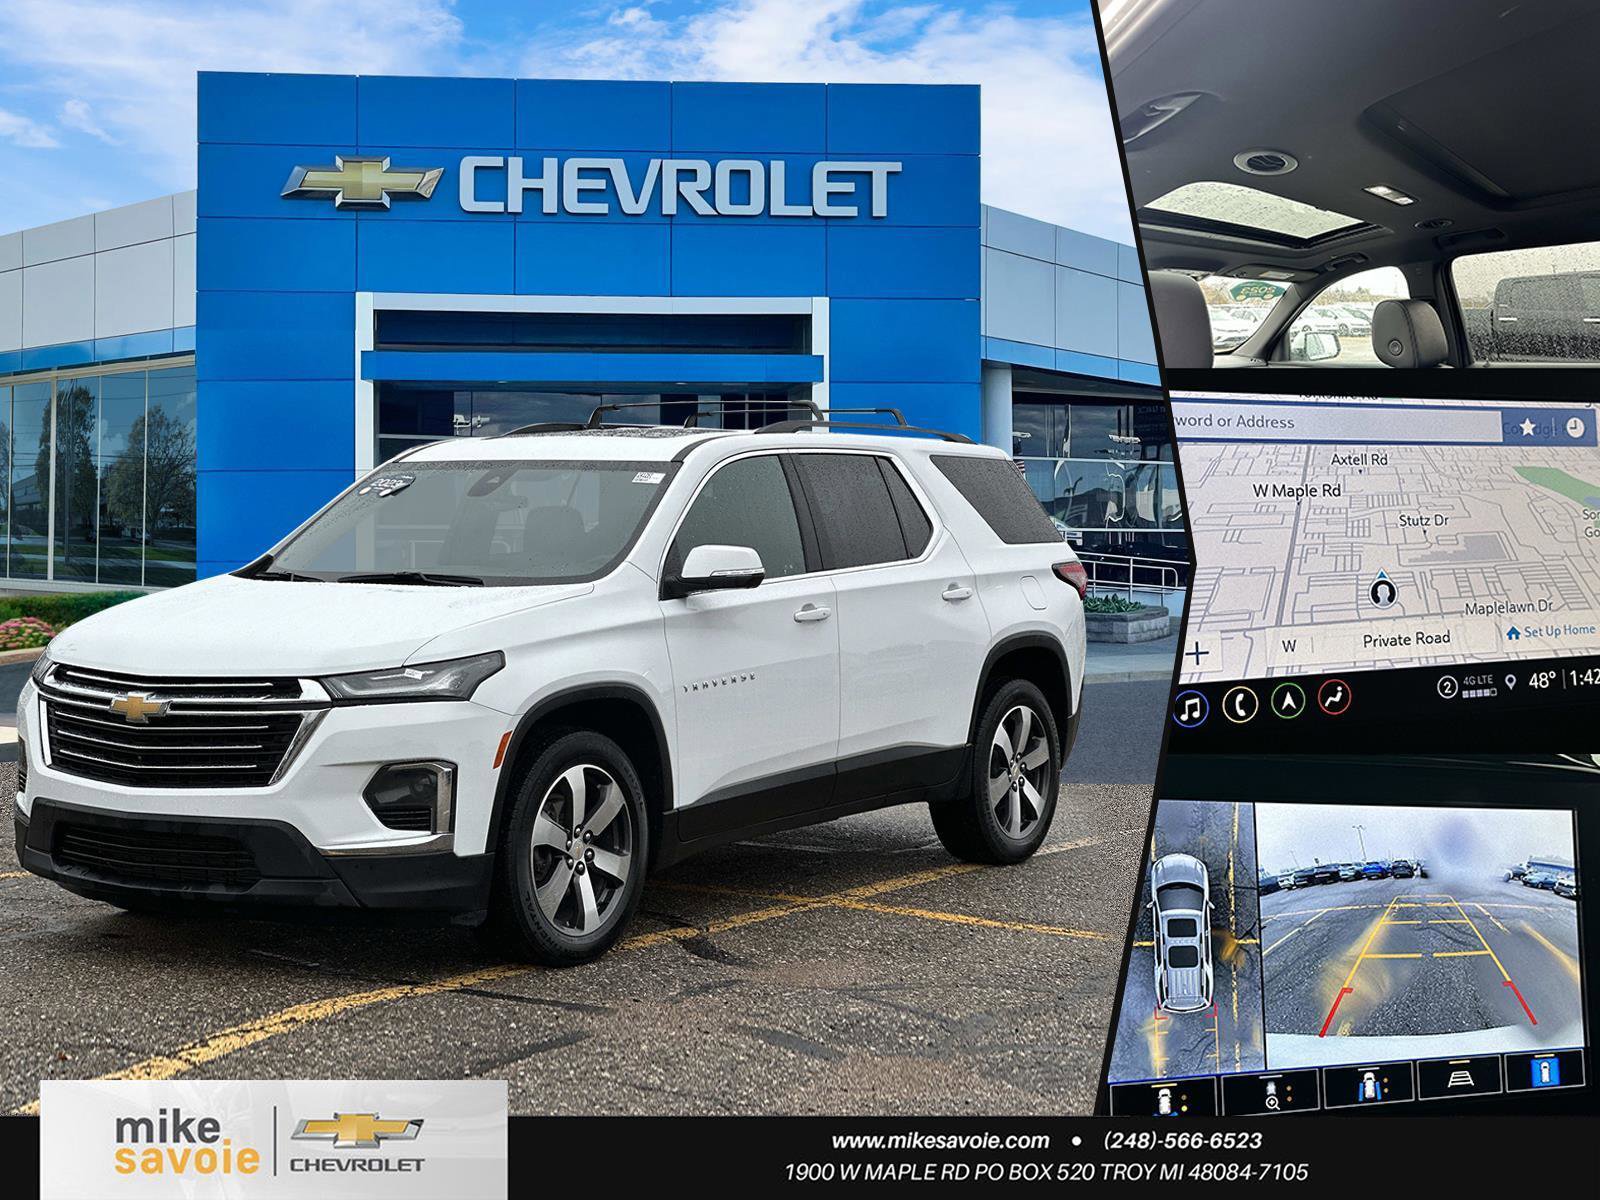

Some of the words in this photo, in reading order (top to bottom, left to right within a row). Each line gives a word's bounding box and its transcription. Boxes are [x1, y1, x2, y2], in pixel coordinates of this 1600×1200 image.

[459, 155, 903, 218] CHEVROLET
[1174, 413, 1213, 428] word
[1217, 418, 1232, 428] or
[1236, 415, 1295, 429] Address
[1331, 453, 1368, 466] Axtell
[1371, 454, 1388, 466] Rd
[1253, 484, 1269, 498] W
[1273, 484, 1318, 501] Maple
[1322, 484, 1342, 497] Rd
[1399, 514, 1431, 527] Stutz
[1434, 515, 1449, 526] Dr
[1465, 601, 1535, 617] Maplelawn
[1538, 599, 1553, 612] Dr
[1363, 632, 1412, 649] Private
[1415, 629, 1451, 645] Road
[1525, 626, 1543, 638] Set
[1545, 626, 1561, 638] Up
[1564, 624, 1596, 635] Home
[1282, 639, 1297, 653] W
[1463, 676, 1476, 685] 4G
[1477, 674, 1494, 685] LTE
[1529, 671, 1557, 689] 48°
[1570, 668, 1600, 686] 1:42
[1443, 681, 1452, 694] 2
